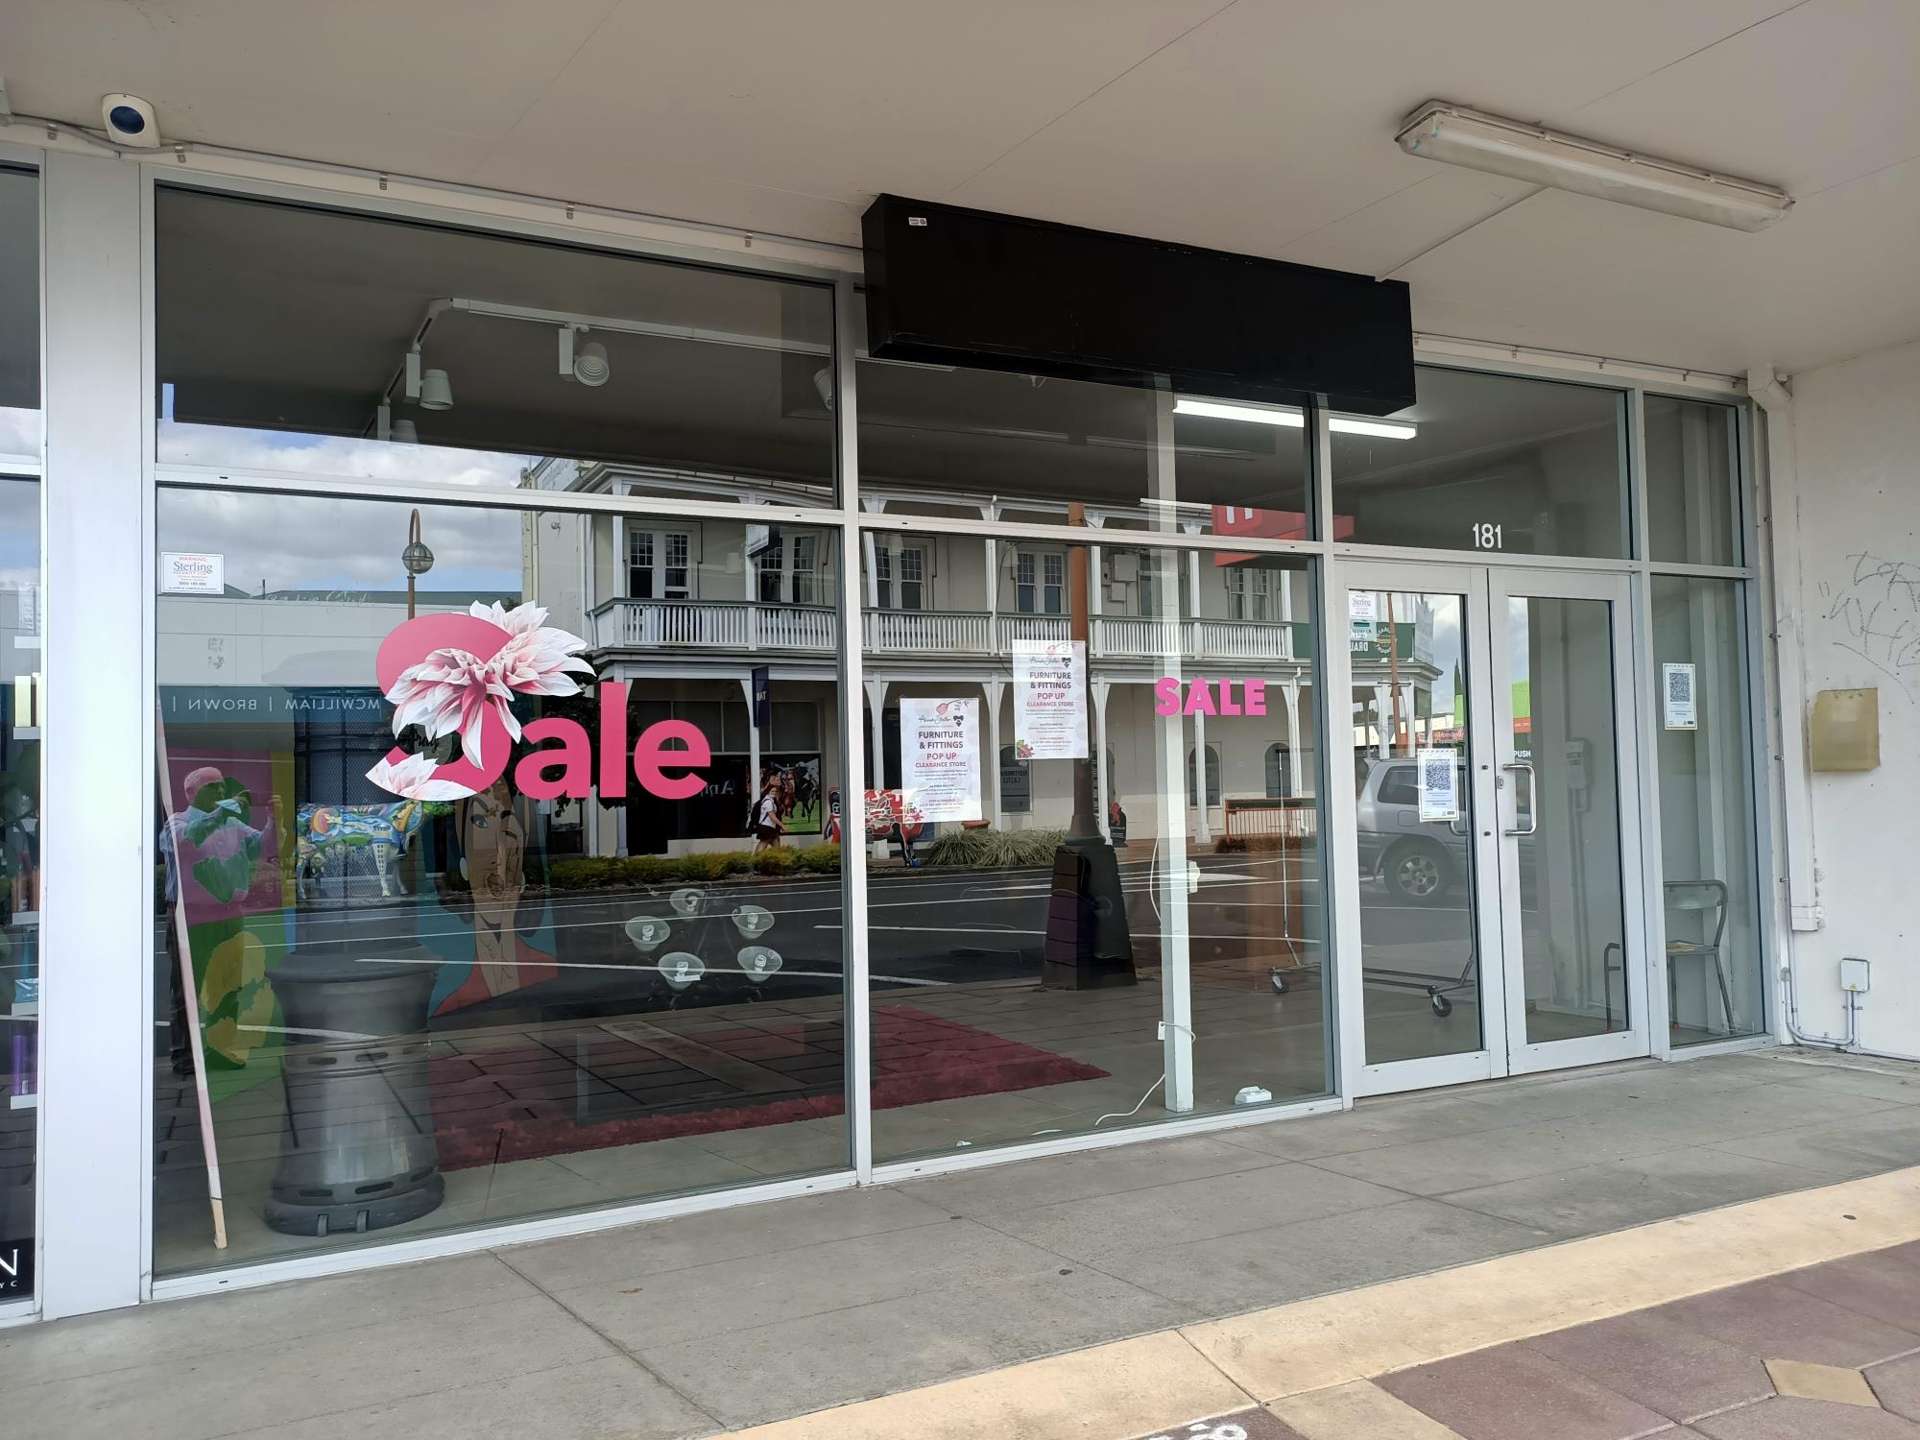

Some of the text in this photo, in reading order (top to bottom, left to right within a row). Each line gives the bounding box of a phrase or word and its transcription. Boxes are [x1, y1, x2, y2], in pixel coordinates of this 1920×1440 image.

[1472, 523, 1502, 549] 181
[173, 560, 214, 575] Sterling
[1029, 671, 1072, 680] FURNITURE
[1037, 692, 1066, 700] POP UP
[1154, 676, 1267, 717] SALE
[918, 731, 964, 739] FURNITURE
[927, 741, 964, 749] FITTINGS
[926, 752, 957, 760] POP UP
[1512, 749, 1532, 758] PUSH
